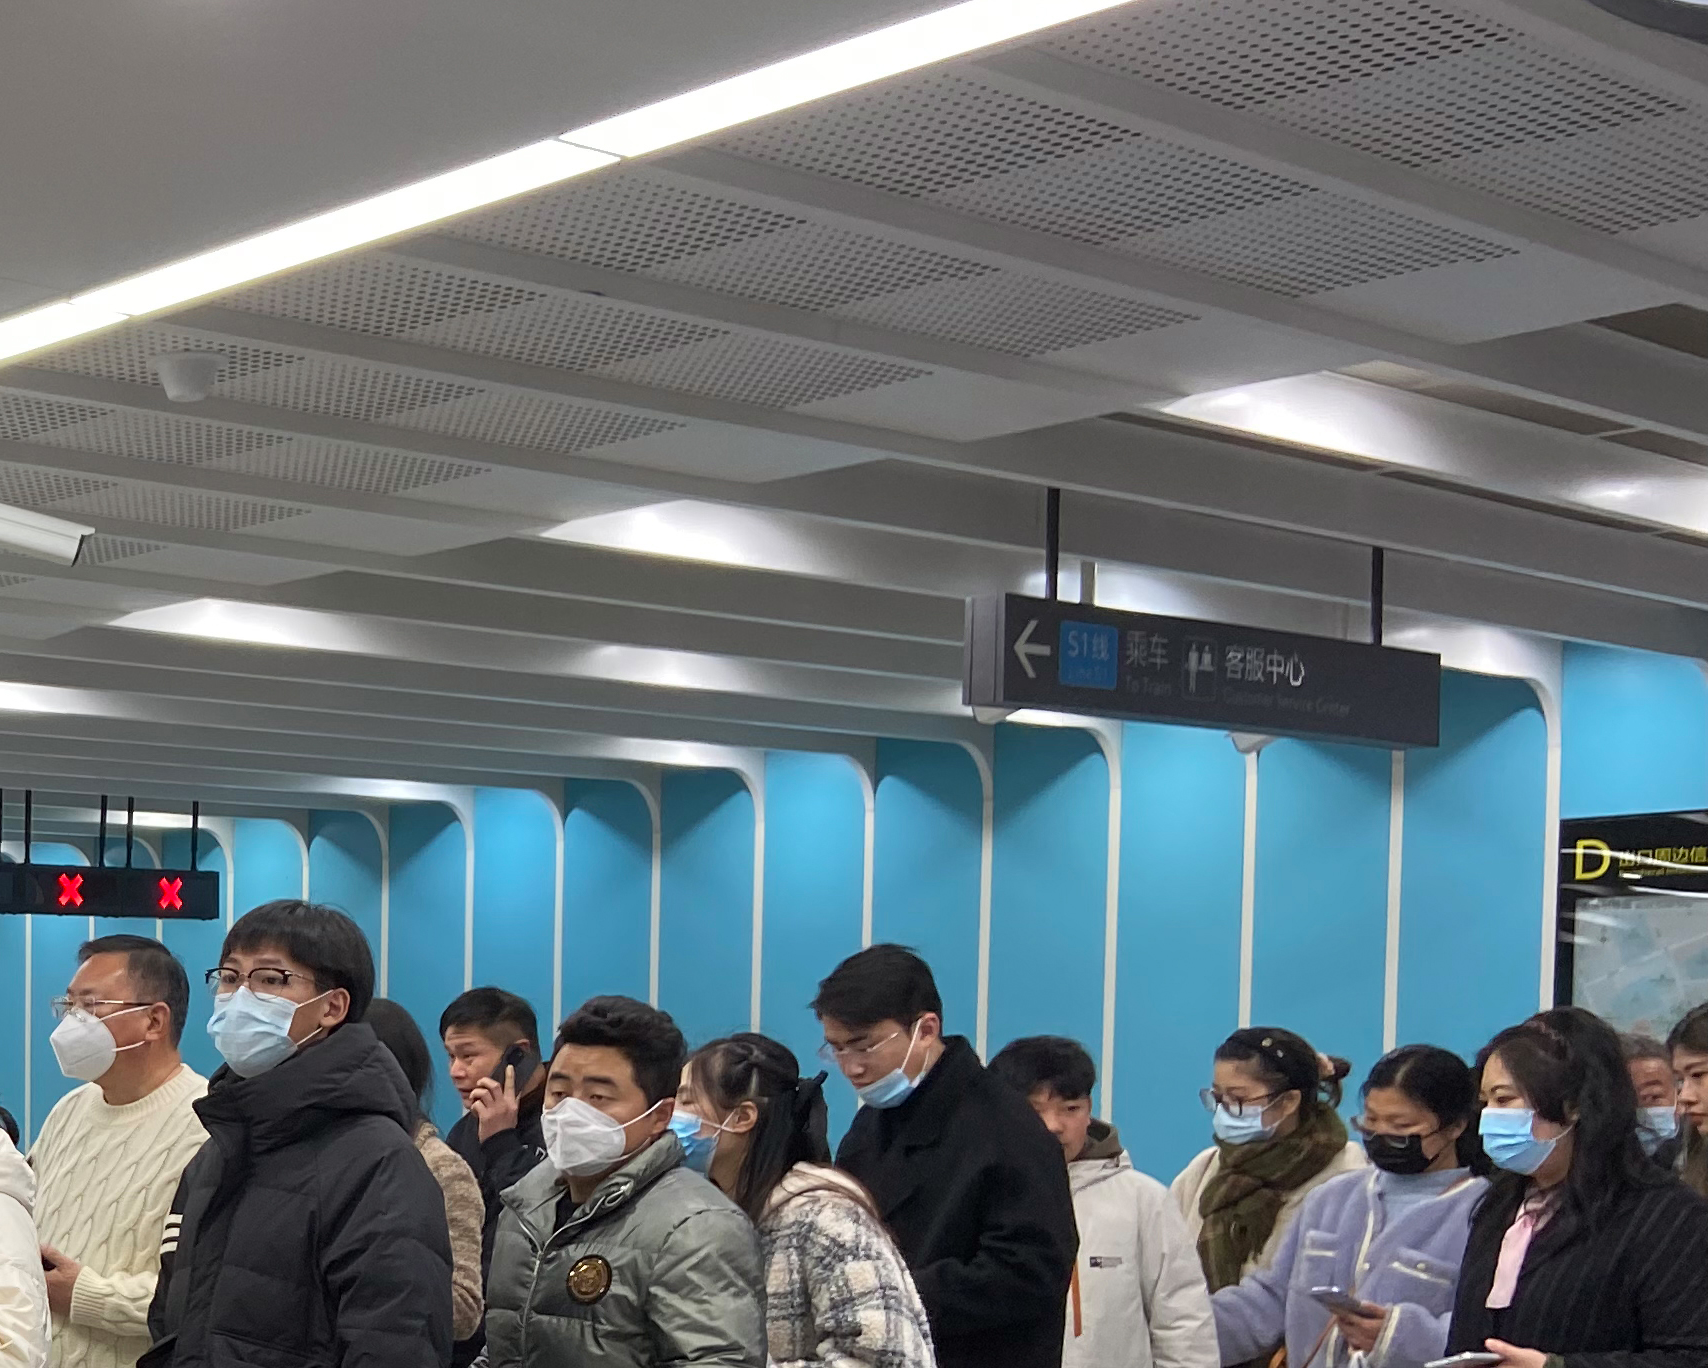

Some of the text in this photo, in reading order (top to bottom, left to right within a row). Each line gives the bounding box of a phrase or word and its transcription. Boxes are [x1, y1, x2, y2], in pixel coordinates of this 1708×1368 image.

[1125, 630, 1170, 671] 乘车
[1225, 644, 1307, 688] 客服中心
[1575, 839, 1611, 880] D
